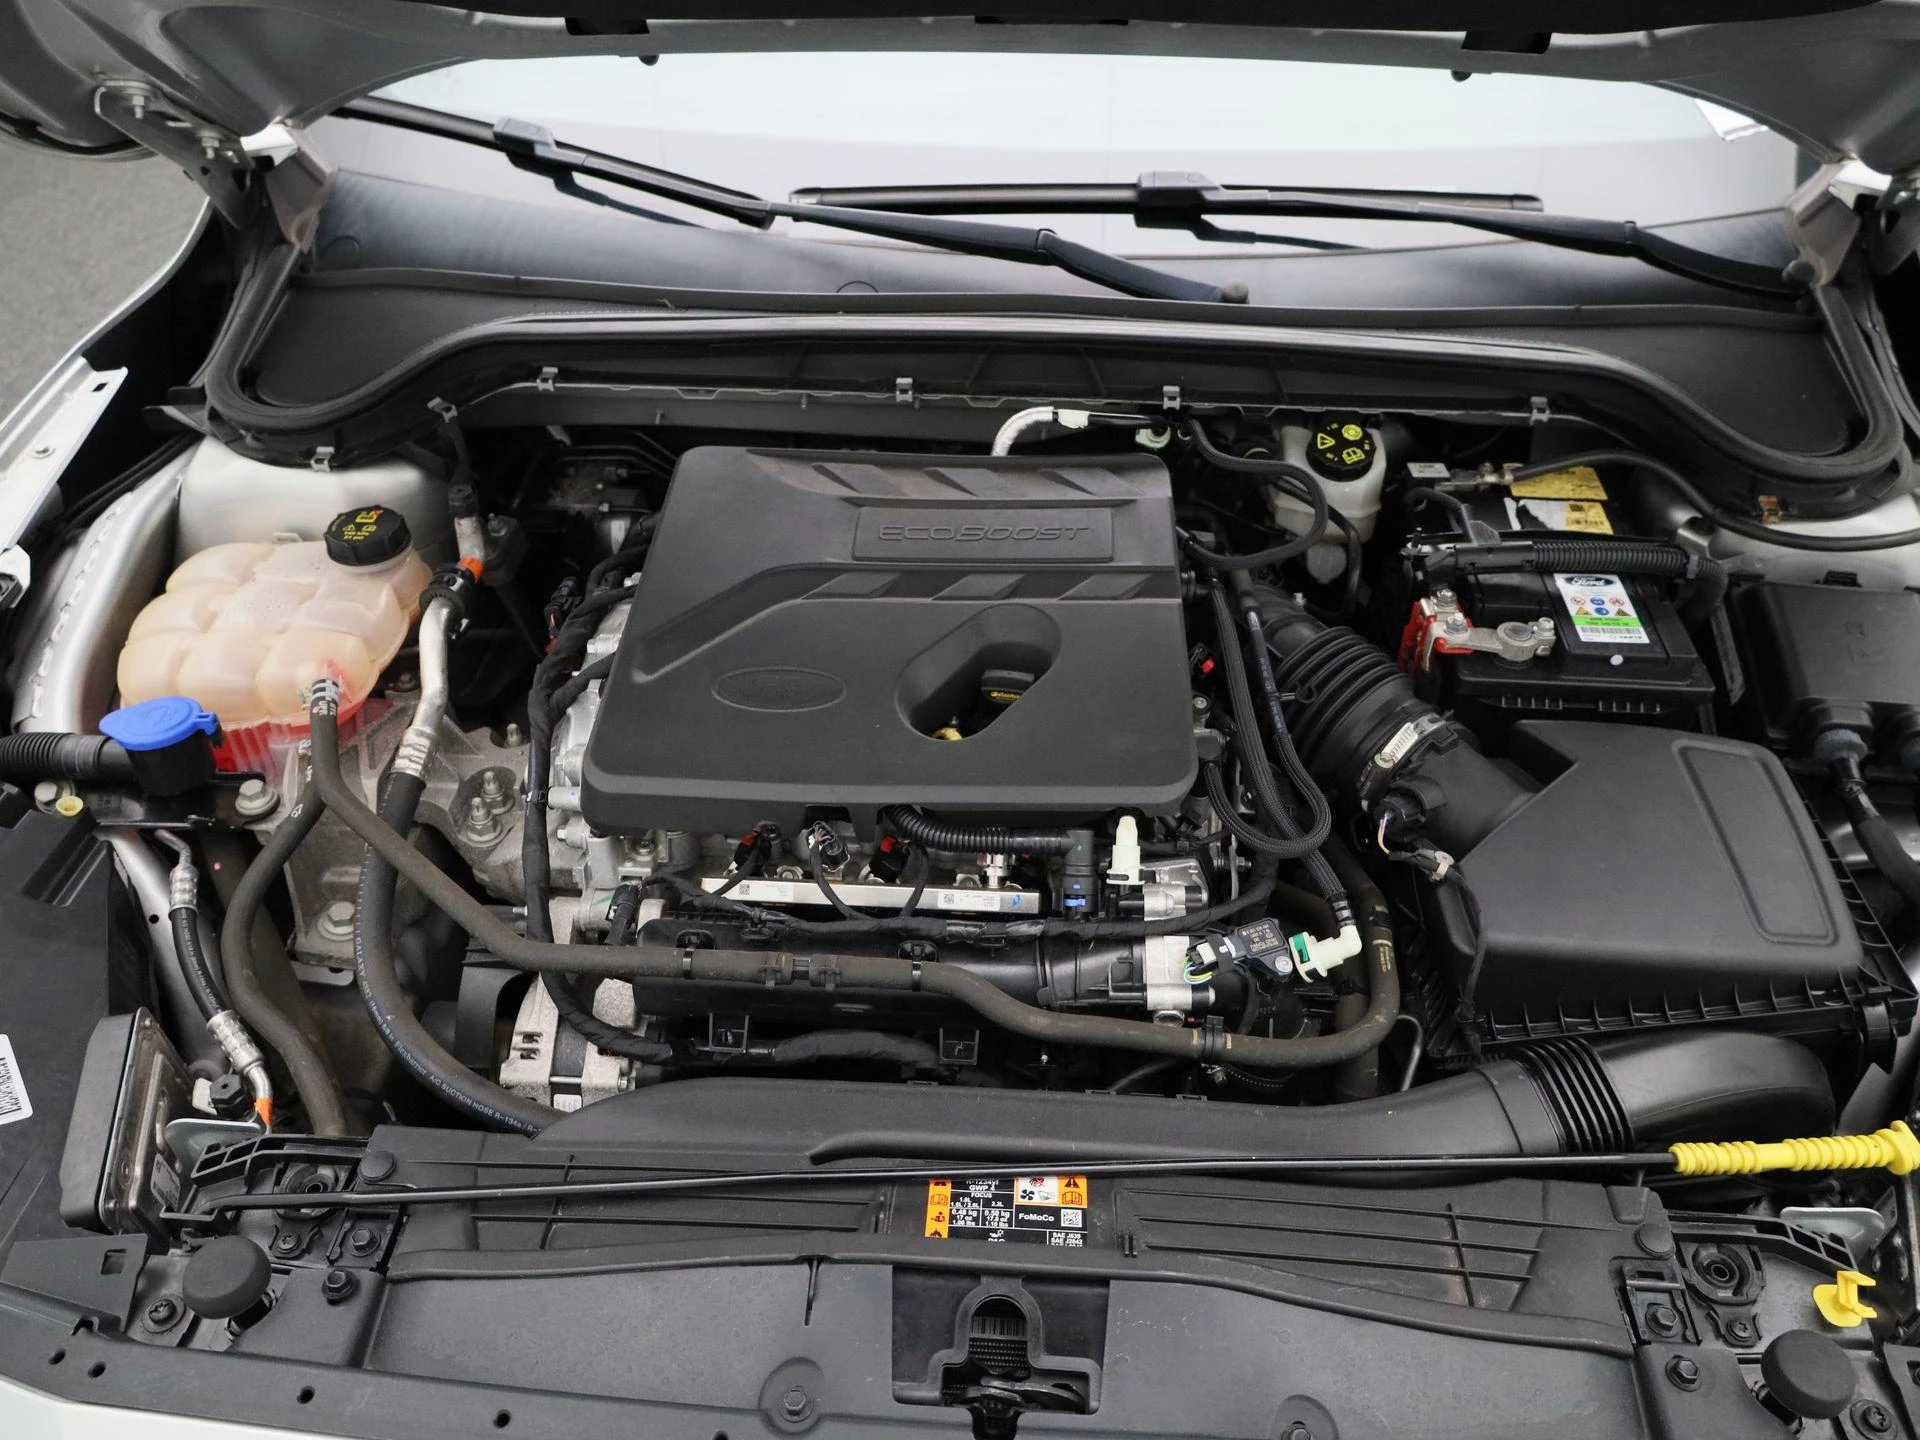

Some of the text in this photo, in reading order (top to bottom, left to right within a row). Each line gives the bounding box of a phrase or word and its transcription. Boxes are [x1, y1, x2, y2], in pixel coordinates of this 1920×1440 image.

[1571, 576, 1606, 586] Ford
[355, 937, 367, 977] GALAXY
[394, 1040, 427, 1076] Flexbarrier
[441, 1083, 473, 1106] SUCTION
[472, 1101, 494, 1117] HOSE
[494, 1112, 522, 1128] R-134a
[1018, 1213, 1055, 1222] FoMoCo
